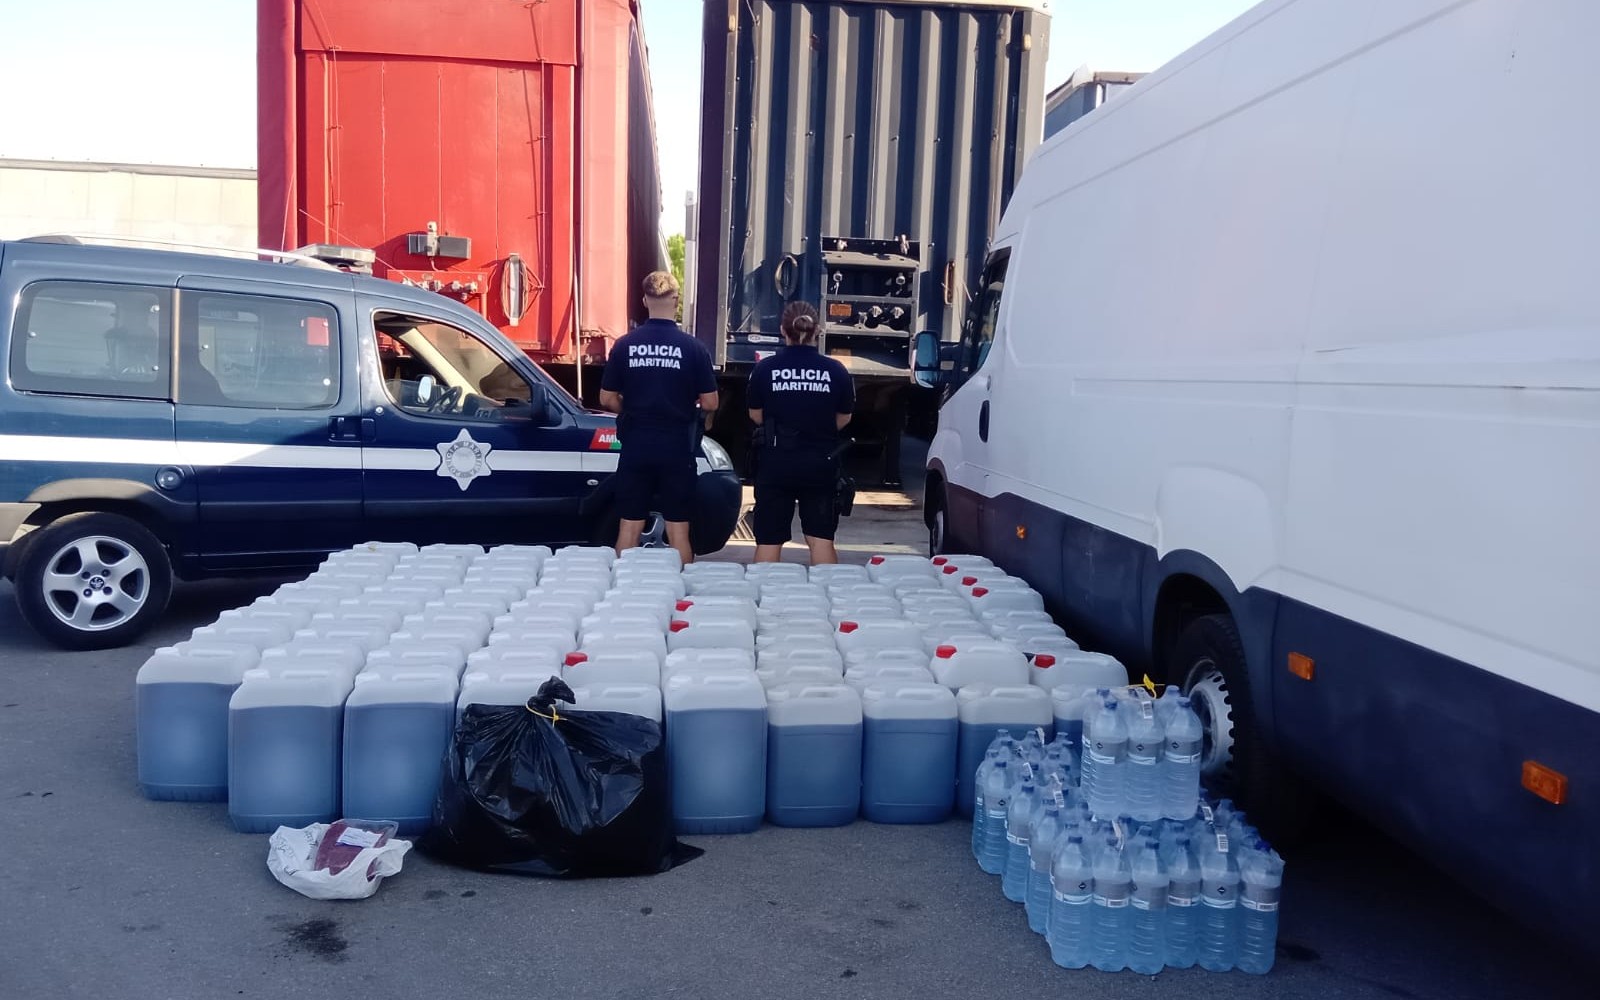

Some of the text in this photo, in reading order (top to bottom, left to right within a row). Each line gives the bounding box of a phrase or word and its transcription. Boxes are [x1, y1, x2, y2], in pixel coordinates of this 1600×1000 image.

[629, 345, 682, 358] POLICIA
[629, 358, 680, 369] MARITIMA
[771, 369, 831, 382] POLICIA
[772, 382, 831, 393] MARITIMA
